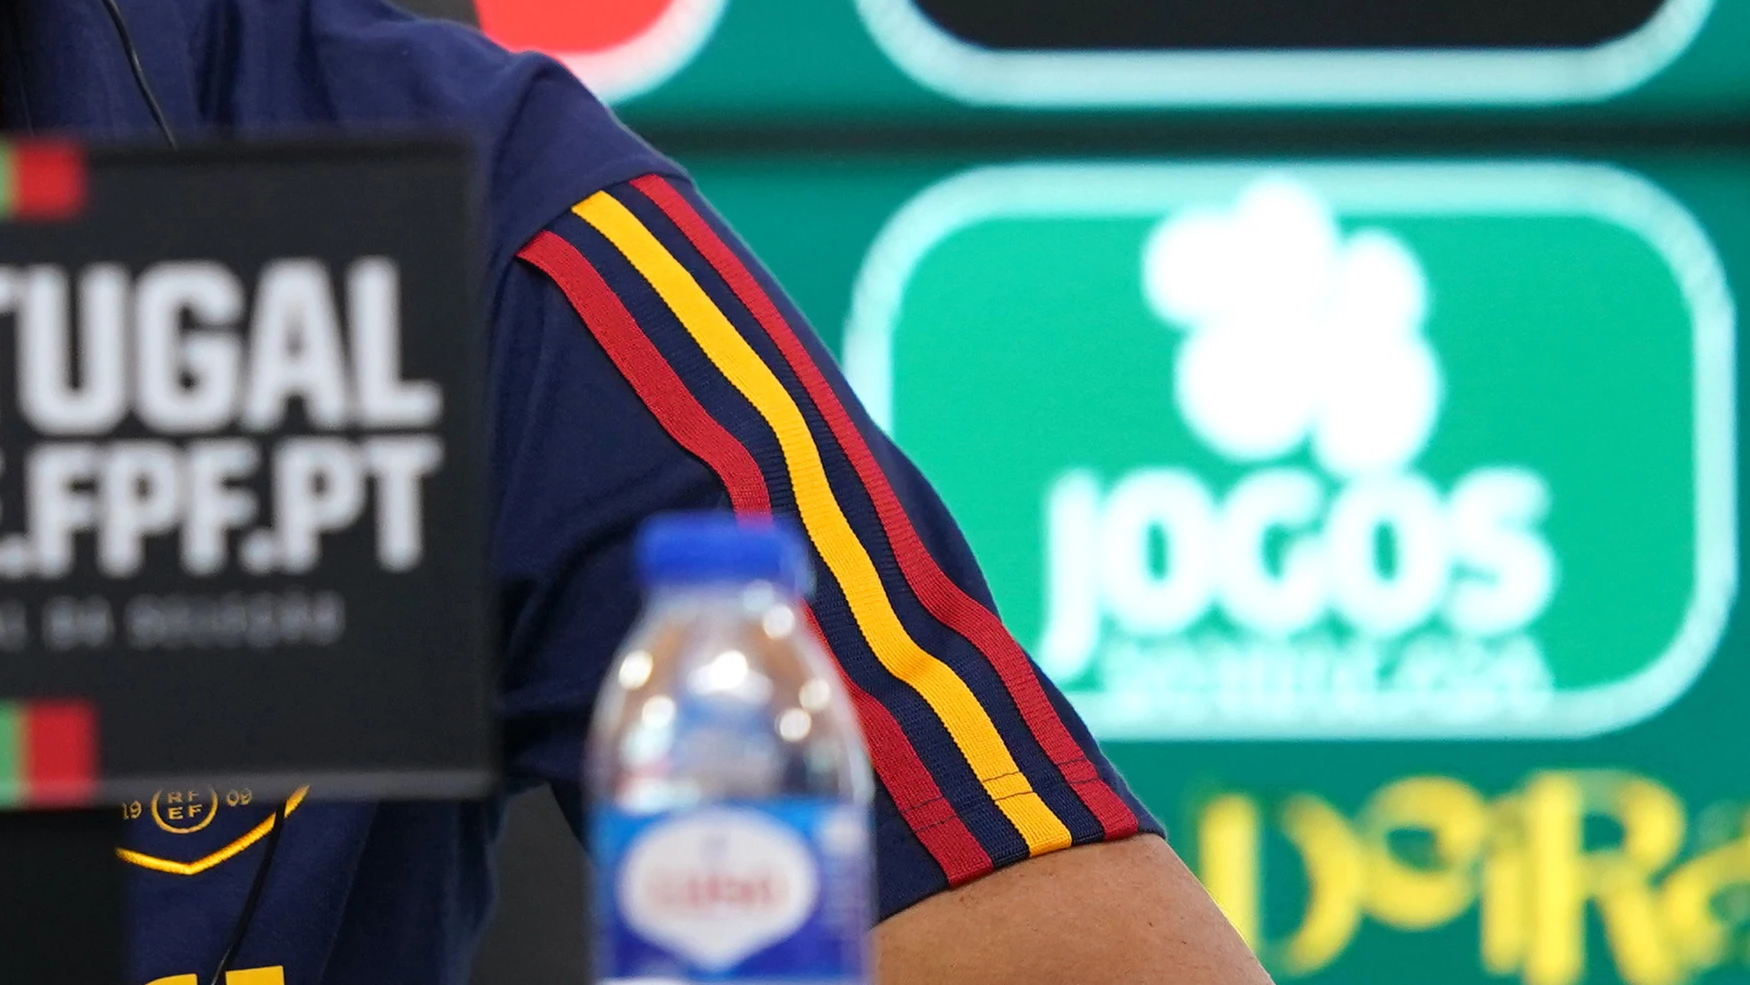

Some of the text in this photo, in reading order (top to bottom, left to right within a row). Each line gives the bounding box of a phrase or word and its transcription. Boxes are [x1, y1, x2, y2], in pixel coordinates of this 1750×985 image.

[1042, 466, 1556, 680] JOGOS
[121, 800, 143, 821] 19
[166, 804, 204, 820] EF
